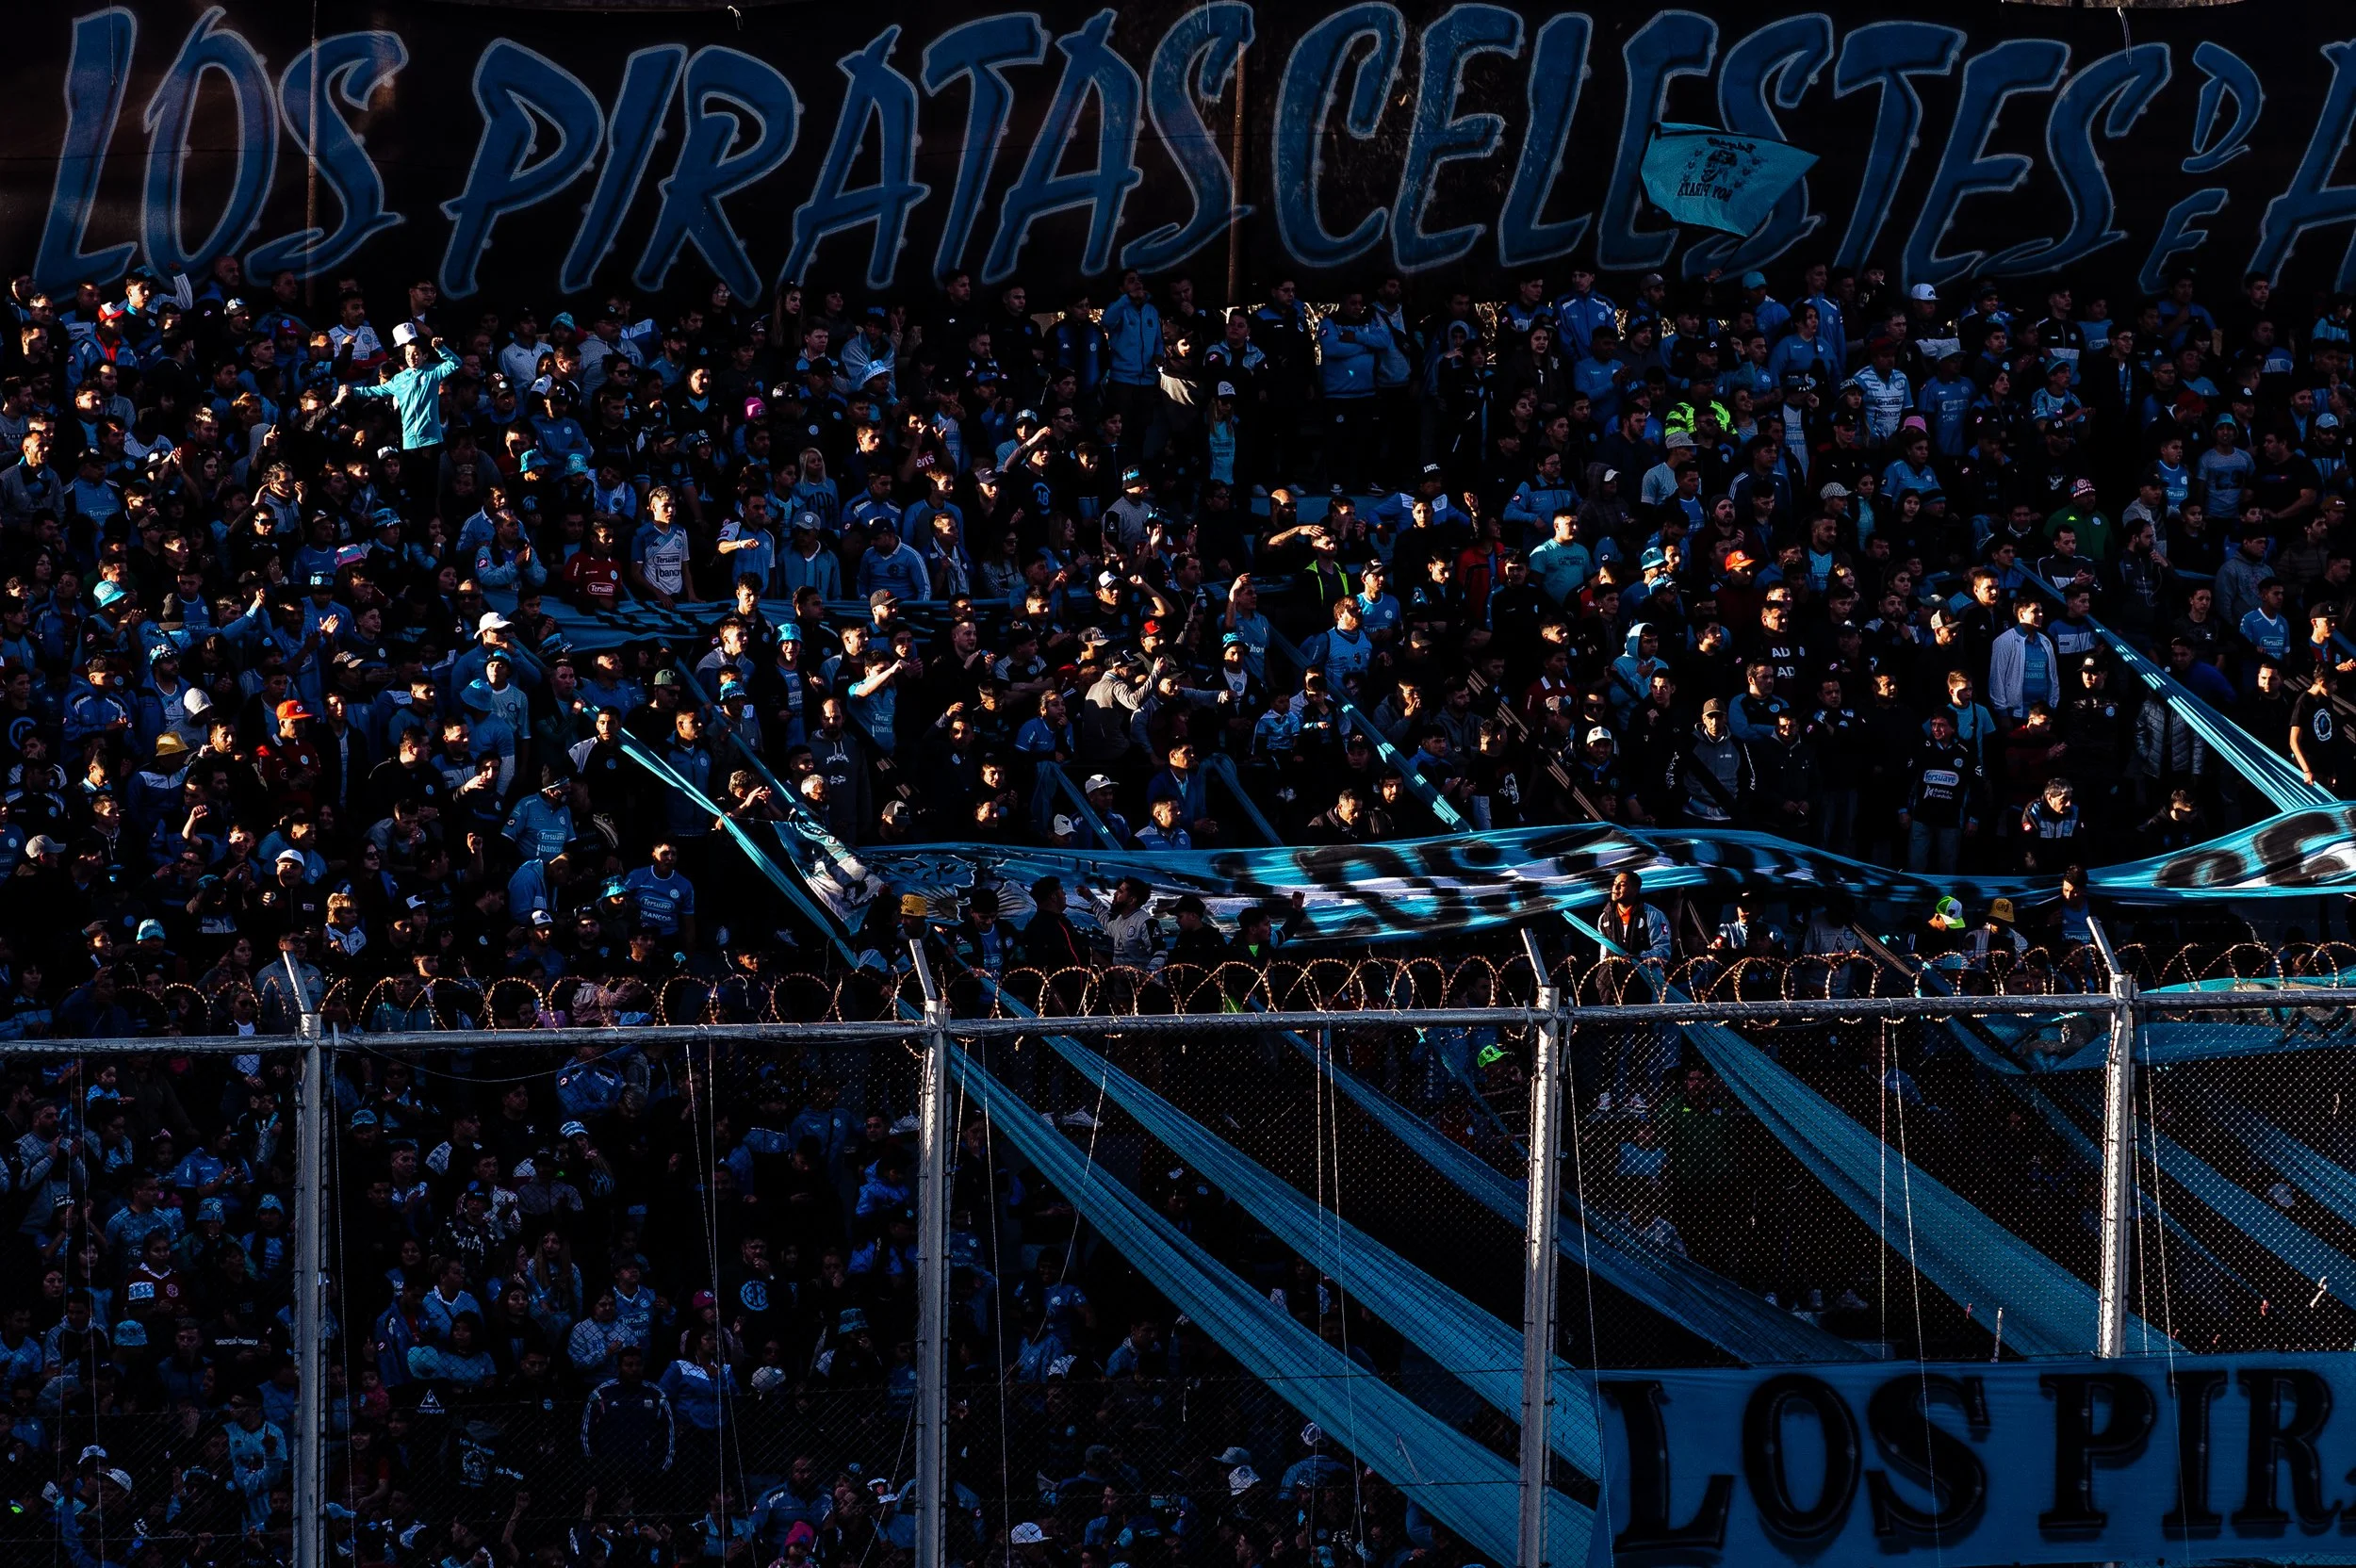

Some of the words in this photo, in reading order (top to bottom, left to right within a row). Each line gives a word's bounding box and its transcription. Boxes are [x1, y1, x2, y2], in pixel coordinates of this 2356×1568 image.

[34, 5, 410, 303] LOS
[439, 1, 1256, 309] PIRATAS
[1272, 2, 2172, 297] CELESTES
[1925, 771, 1955, 785] Tersuave
[644, 899, 672, 910] Tersuave
[1597, 1373, 1988, 1553] LOS
[2037, 1369, 2356, 1530] PIR
